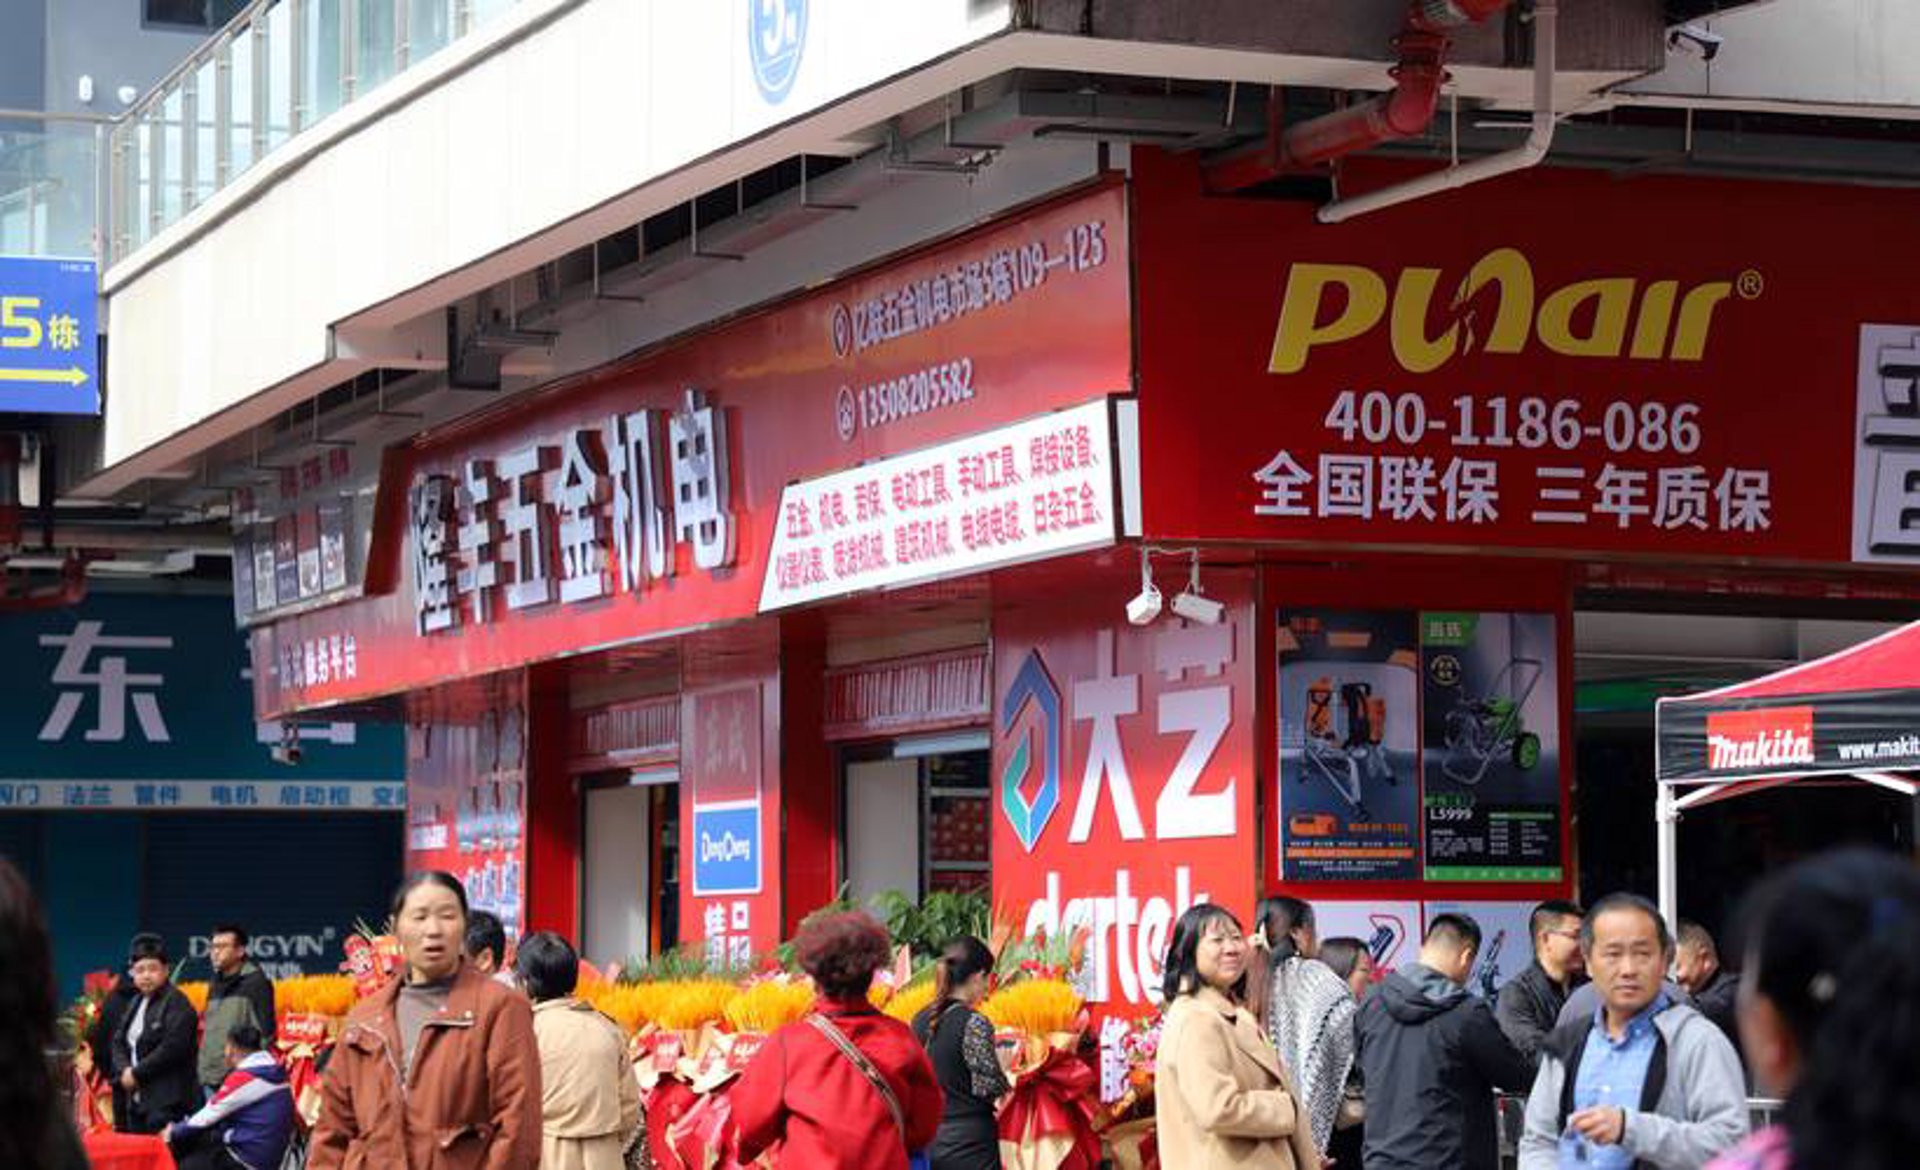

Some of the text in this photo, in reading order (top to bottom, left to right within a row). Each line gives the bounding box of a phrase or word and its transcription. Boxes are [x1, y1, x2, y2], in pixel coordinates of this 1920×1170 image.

[1, 296, 79, 352] 5栋
[1323, 390, 1702, 454] 400-1186-086
[1252, 450, 1771, 533] 全国联保 三年质保
[1067, 619, 1238, 846] 大艺
[1707, 729, 1815, 769] makita
[1025, 866, 1209, 1005] darte
